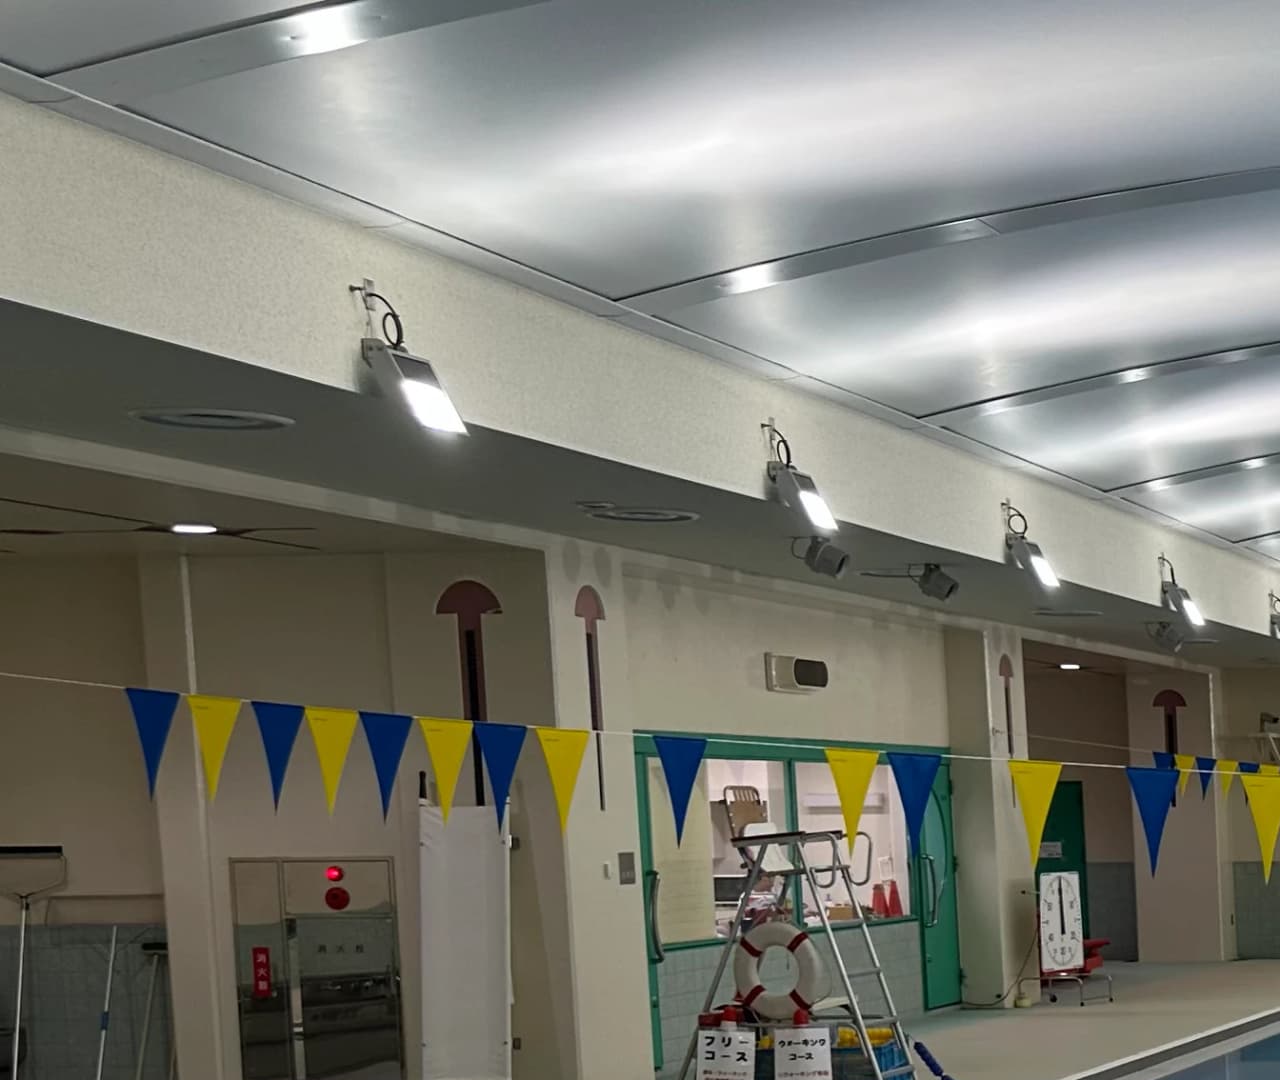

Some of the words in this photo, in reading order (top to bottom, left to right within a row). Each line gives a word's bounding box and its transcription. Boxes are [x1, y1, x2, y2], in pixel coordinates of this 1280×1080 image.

[704, 1036, 749, 1048] フリー
[704, 1051, 748, 1062] コース
[788, 1052, 814, 1061] コース
